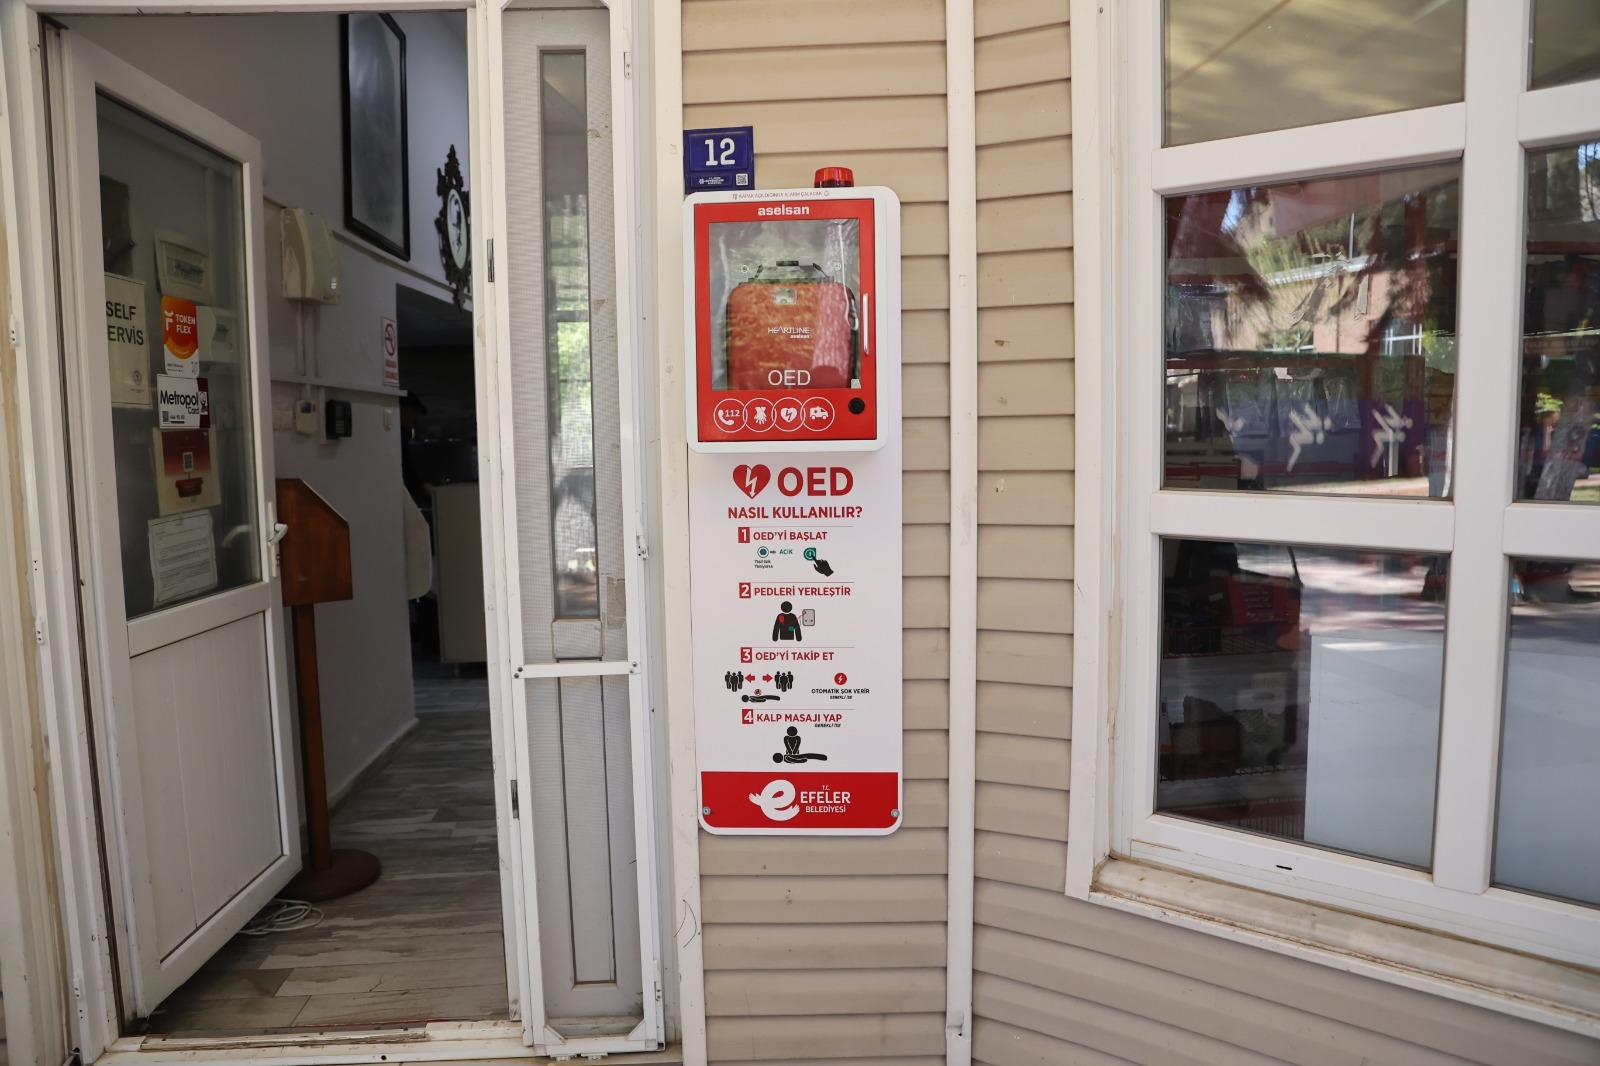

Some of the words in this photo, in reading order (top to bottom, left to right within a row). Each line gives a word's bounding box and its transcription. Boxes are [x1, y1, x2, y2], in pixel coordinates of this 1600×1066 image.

[704, 137, 736, 167] 12
[757, 204, 810, 216] aselsan
[106, 300, 136, 321] SELF
[175, 313, 196, 325] TOKEN
[107, 325, 144, 345] ERVİS
[176, 324, 192, 335] FLEX
[767, 369, 811, 387] OED
[160, 389, 199, 409] Metropol
[725, 409, 740, 418] 112
[777, 466, 854, 497] OED
[728, 506, 769, 519] NASIL
[772, 505, 863, 519] KULLANILIR?
[741, 529, 747, 542] 1
[789, 531, 828, 542] BAŞLAT
[741, 584, 750, 598] 2
[754, 585, 796, 596] PEDLERİ
[798, 585, 851, 598] YERLEŞTİR
[742, 648, 751, 662] 3
[791, 650, 820, 661] TAKİP
[822, 652, 835, 661] ET
[744, 711, 753, 723] 4
[756, 713, 783, 723] KALP
[784, 713, 821, 723] MASAJI
[823, 713, 843, 723] YAP
[800, 791, 851, 804] EFELER
[805, 803, 846, 813] BELEDİYESİ
